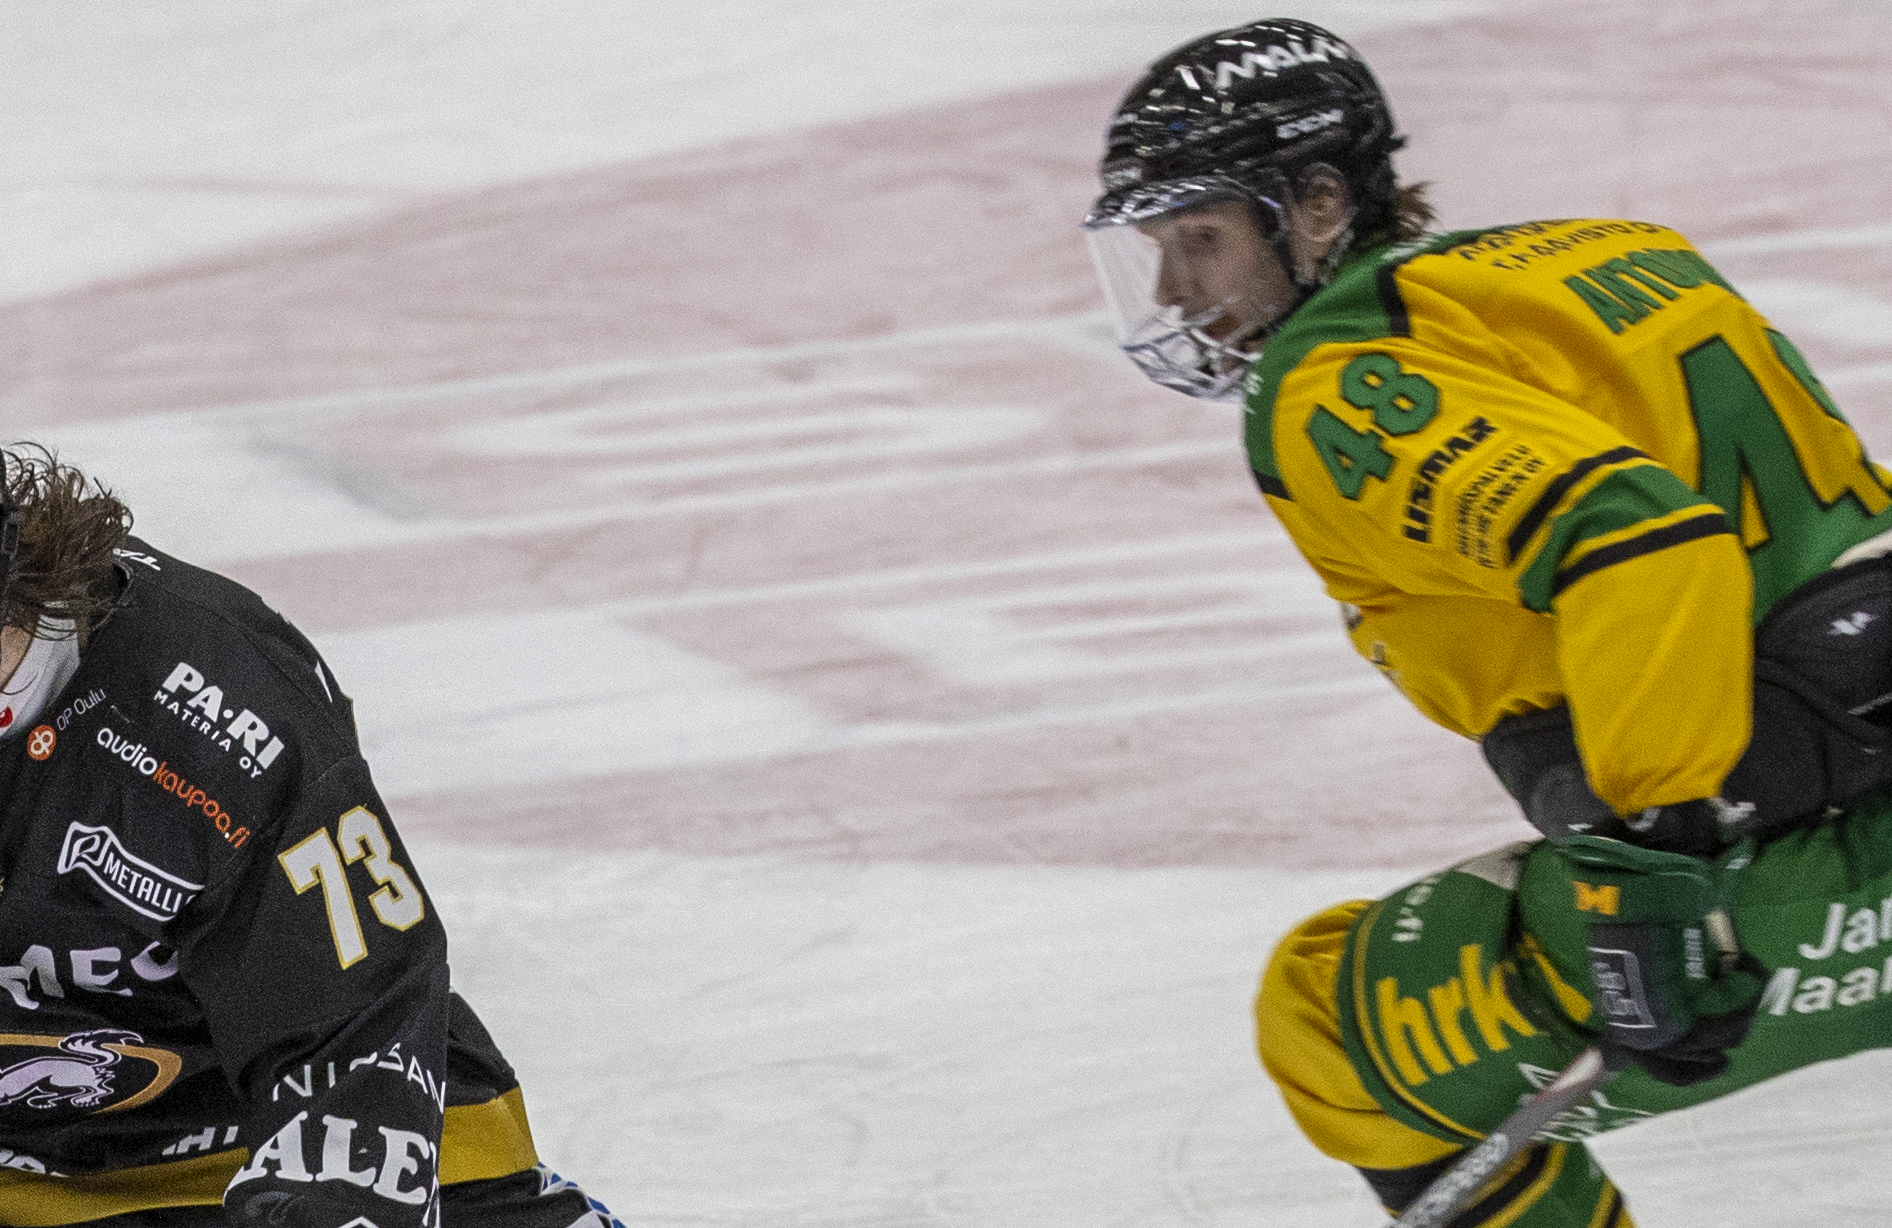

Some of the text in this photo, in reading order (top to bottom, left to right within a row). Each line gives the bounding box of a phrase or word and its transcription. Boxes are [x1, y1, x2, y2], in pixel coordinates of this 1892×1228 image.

[1305, 351, 1443, 501] 48
[153, 690, 262, 779] MATERIA OY
[277, 804, 425, 970] 73
